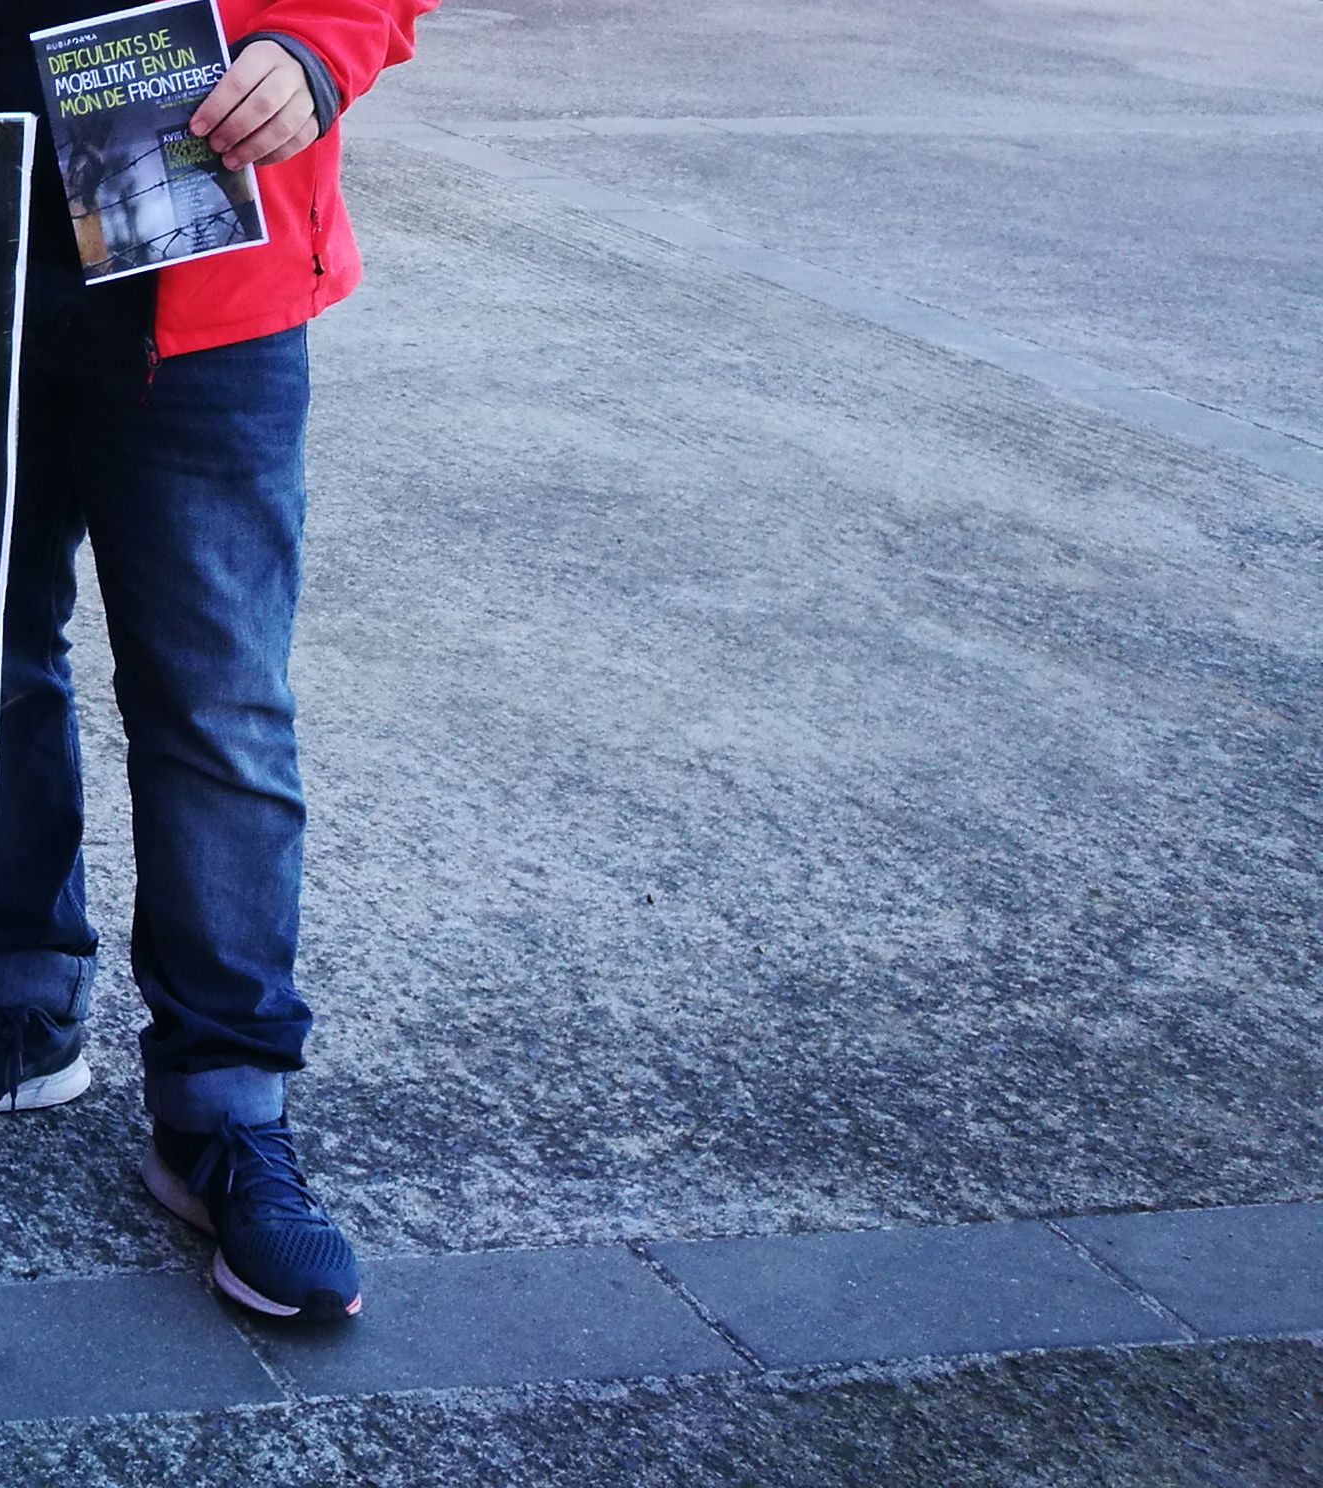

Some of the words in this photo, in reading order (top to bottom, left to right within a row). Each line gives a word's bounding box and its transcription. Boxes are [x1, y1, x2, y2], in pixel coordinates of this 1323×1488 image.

[48, 35, 148, 75] DIFICULTATS
[149, 28, 172, 51] DE
[55, 60, 136, 97] MOBILITAT
[142, 55, 166, 77] EN
[169, 47, 196, 69] UN
[60, 92, 102, 118] MÓN
[104, 86, 127, 109] DE
[128, 63, 226, 103] FRONTERES
